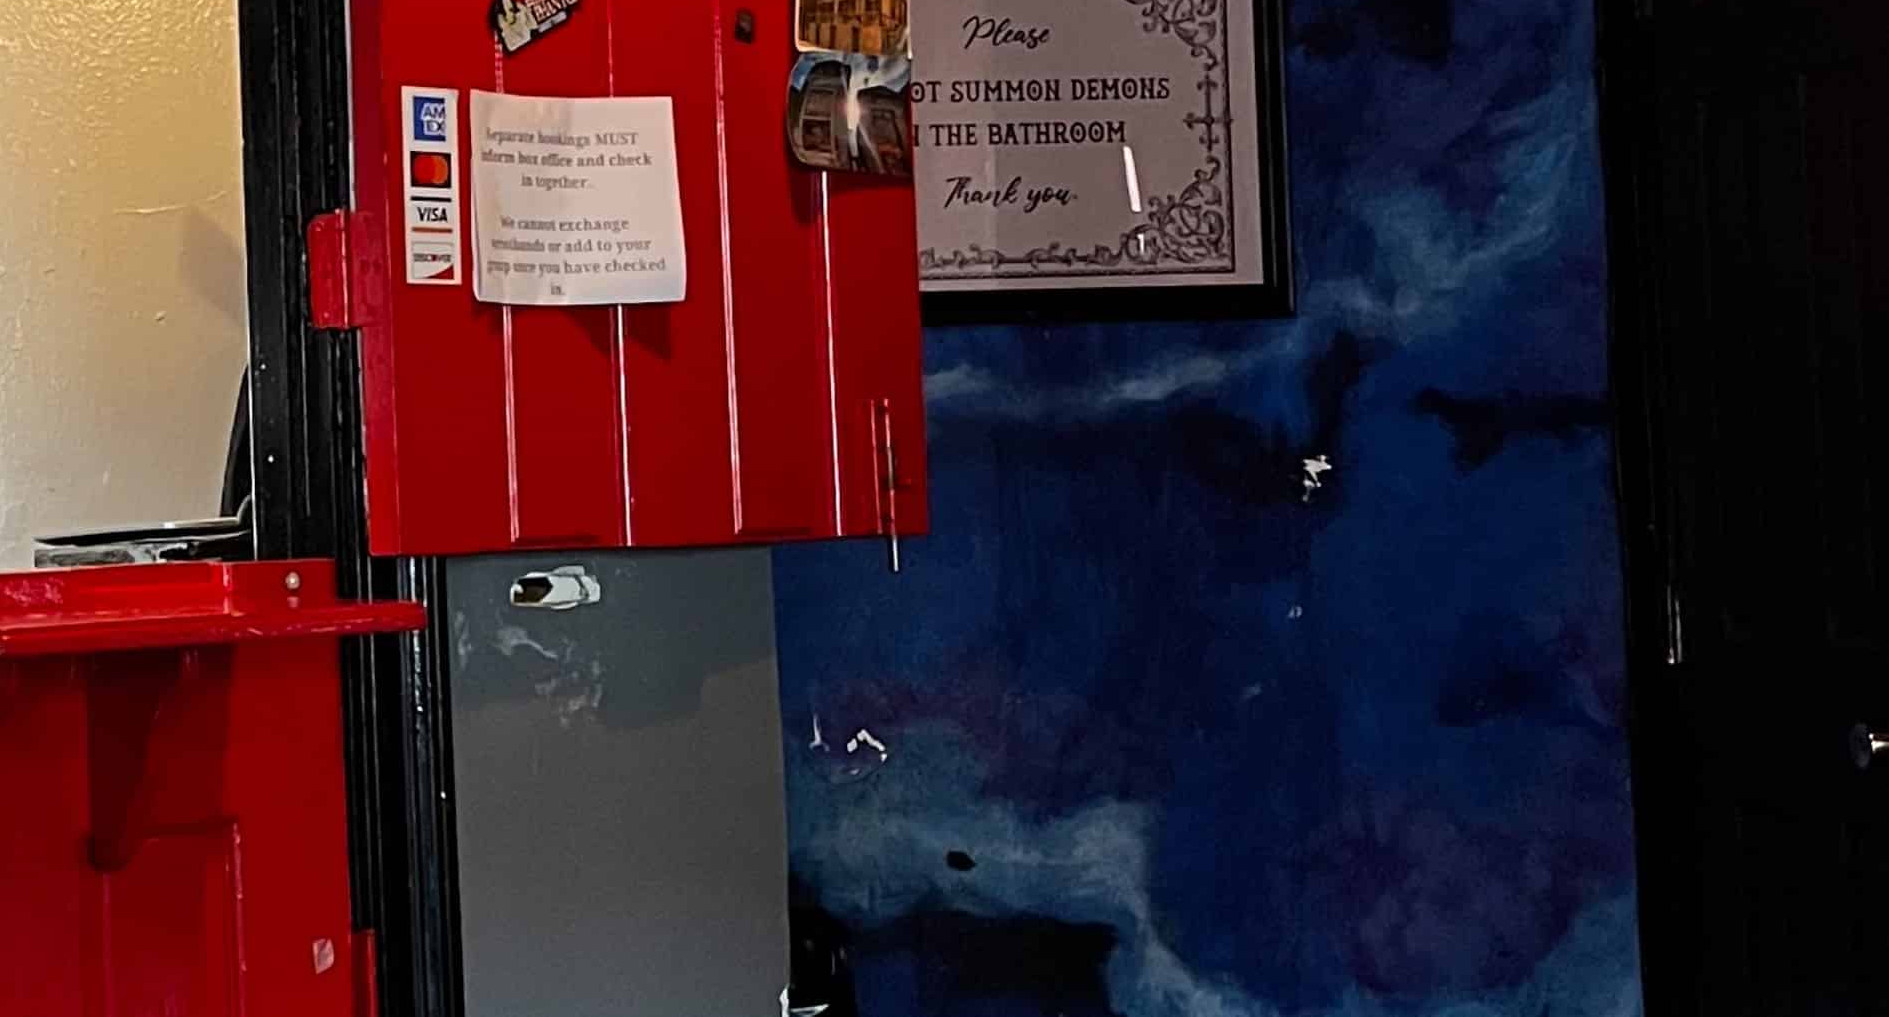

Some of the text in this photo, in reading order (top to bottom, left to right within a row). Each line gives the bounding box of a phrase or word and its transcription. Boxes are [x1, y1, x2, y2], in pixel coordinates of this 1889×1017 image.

[962, 14, 1053, 50] Please
[950, 79, 1063, 104] SUMMON
[1071, 77, 1171, 101] DEMONS
[422, 102, 446, 119] AM
[425, 119, 446, 133] EX
[928, 123, 977, 148] THE
[987, 121, 1127, 145] BATHROOM
[594, 132, 639, 147] MUST
[576, 153, 606, 167] and
[608, 151, 653, 167] check
[943, 175, 1023, 210] Thank
[417, 206, 449, 222] VISA
[558, 217, 630, 233] exchange
[564, 238, 593, 254] add
[596, 238, 613, 252] to
[615, 239, 653, 255] your
[538, 262, 561, 277] you
[563, 259, 601, 275] have
[604, 258, 667, 273] checked
